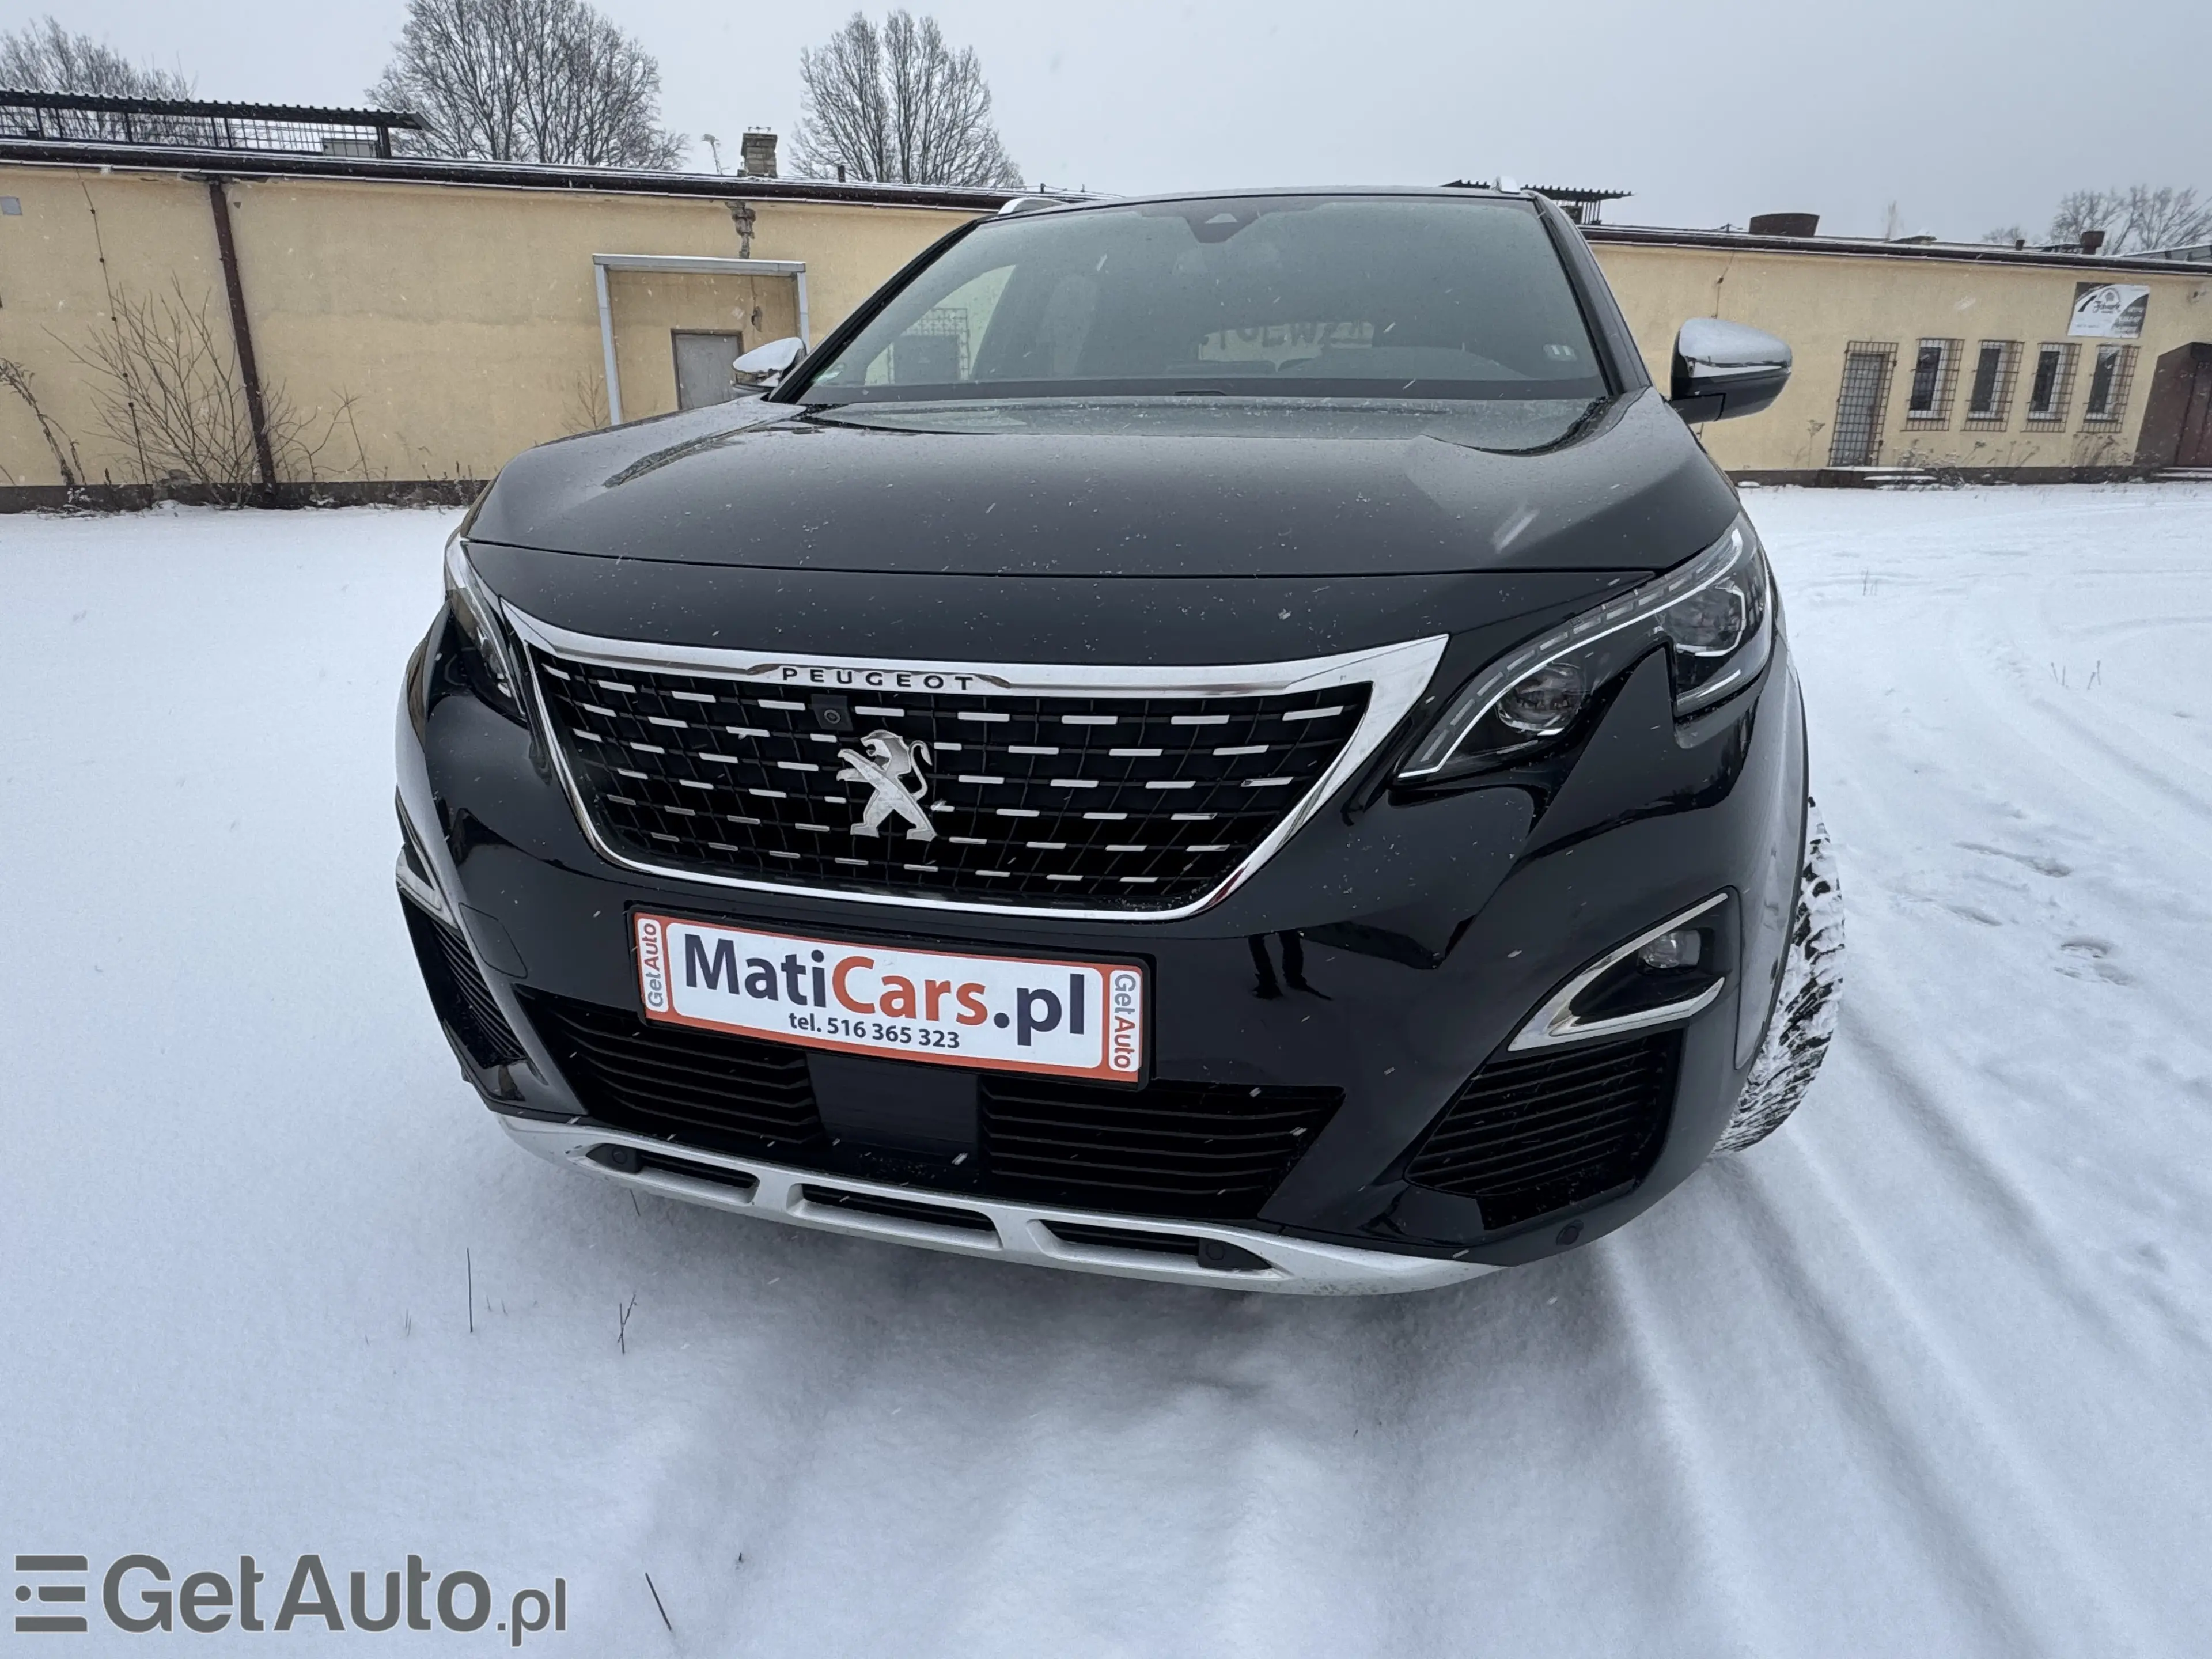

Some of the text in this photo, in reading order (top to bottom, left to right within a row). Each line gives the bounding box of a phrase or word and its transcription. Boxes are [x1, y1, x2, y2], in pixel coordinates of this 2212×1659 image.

[782, 666, 974, 691] PEUGEOT
[641, 923, 664, 1007] GetAuto
[684, 933, 1085, 1047] MatiCars.pl
[789, 1012, 960, 1050] tel. 516 365 323
[1113, 974, 1137, 1069] GetAuto
